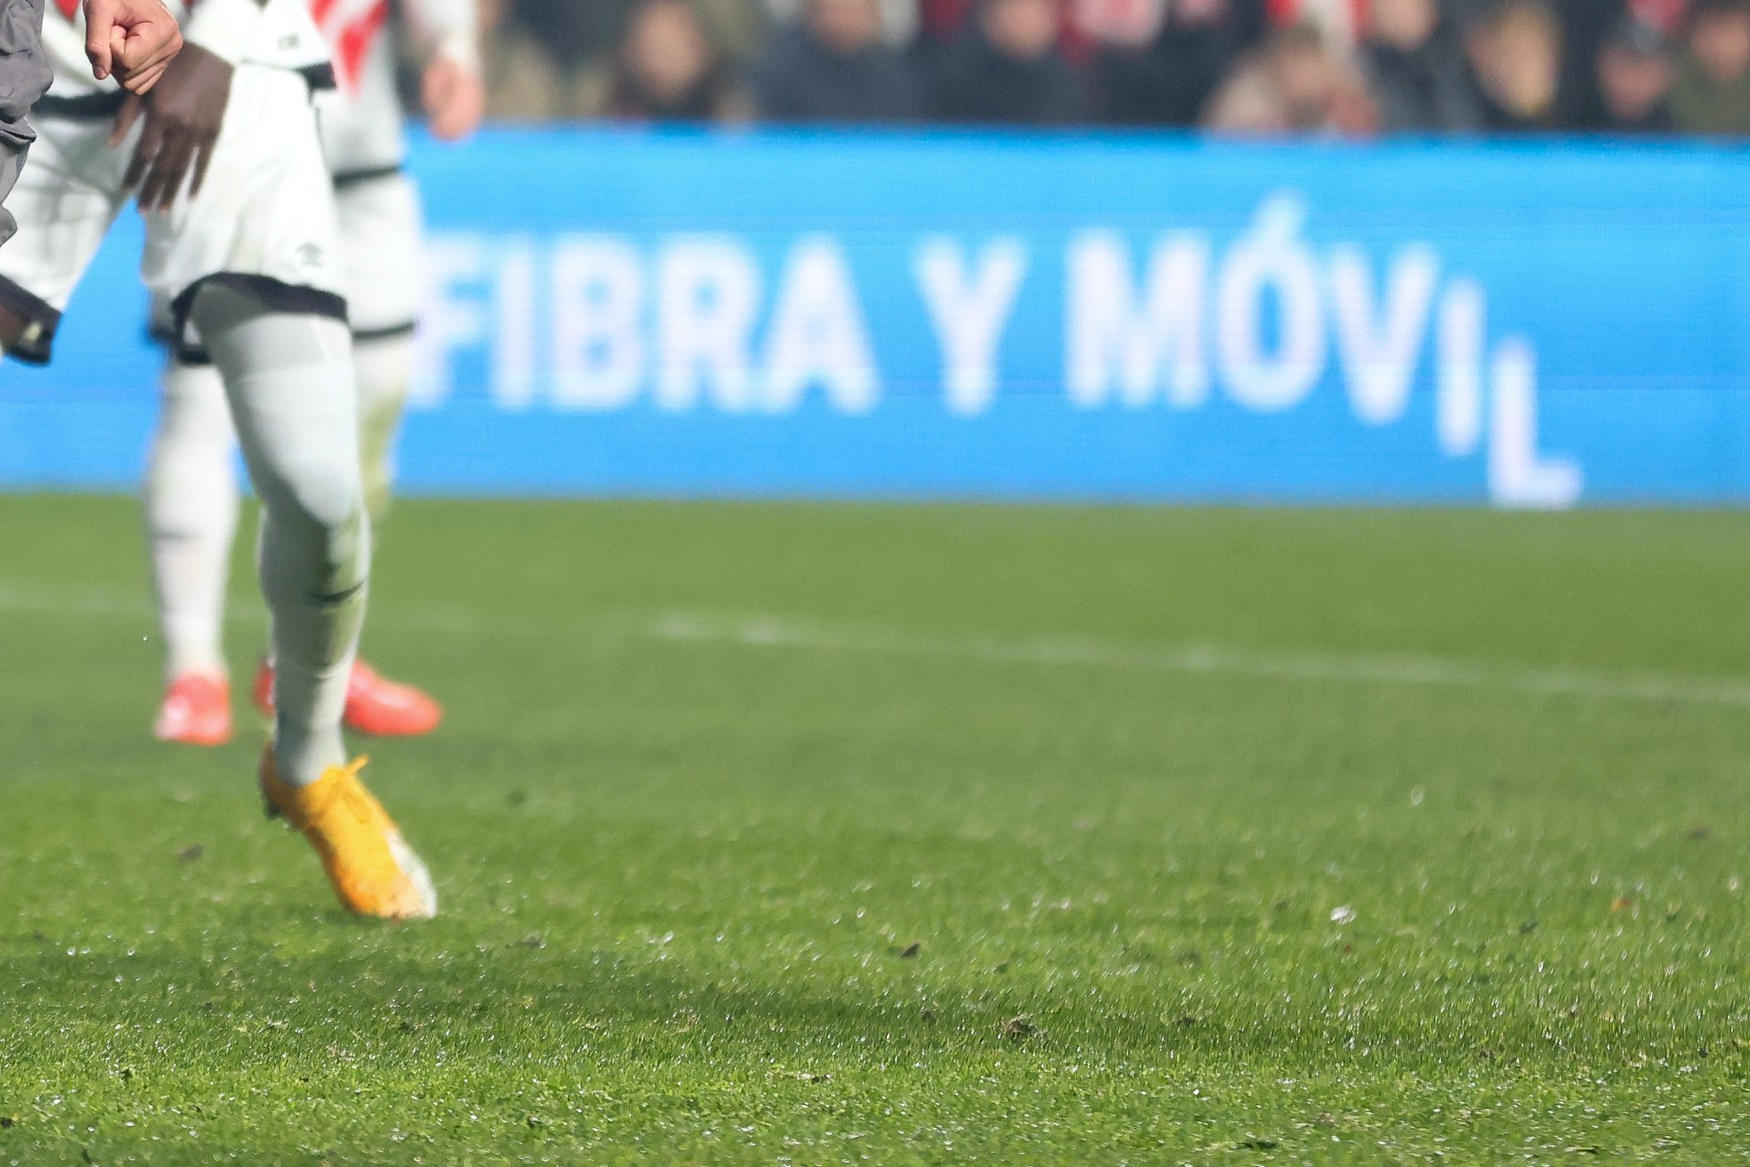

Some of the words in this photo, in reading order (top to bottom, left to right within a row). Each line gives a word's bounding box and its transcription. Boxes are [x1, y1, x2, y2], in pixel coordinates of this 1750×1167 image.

[408, 235, 882, 413] FIBRA
[913, 235, 1028, 416] Y
[1065, 188, 1583, 508] MÓVIL
